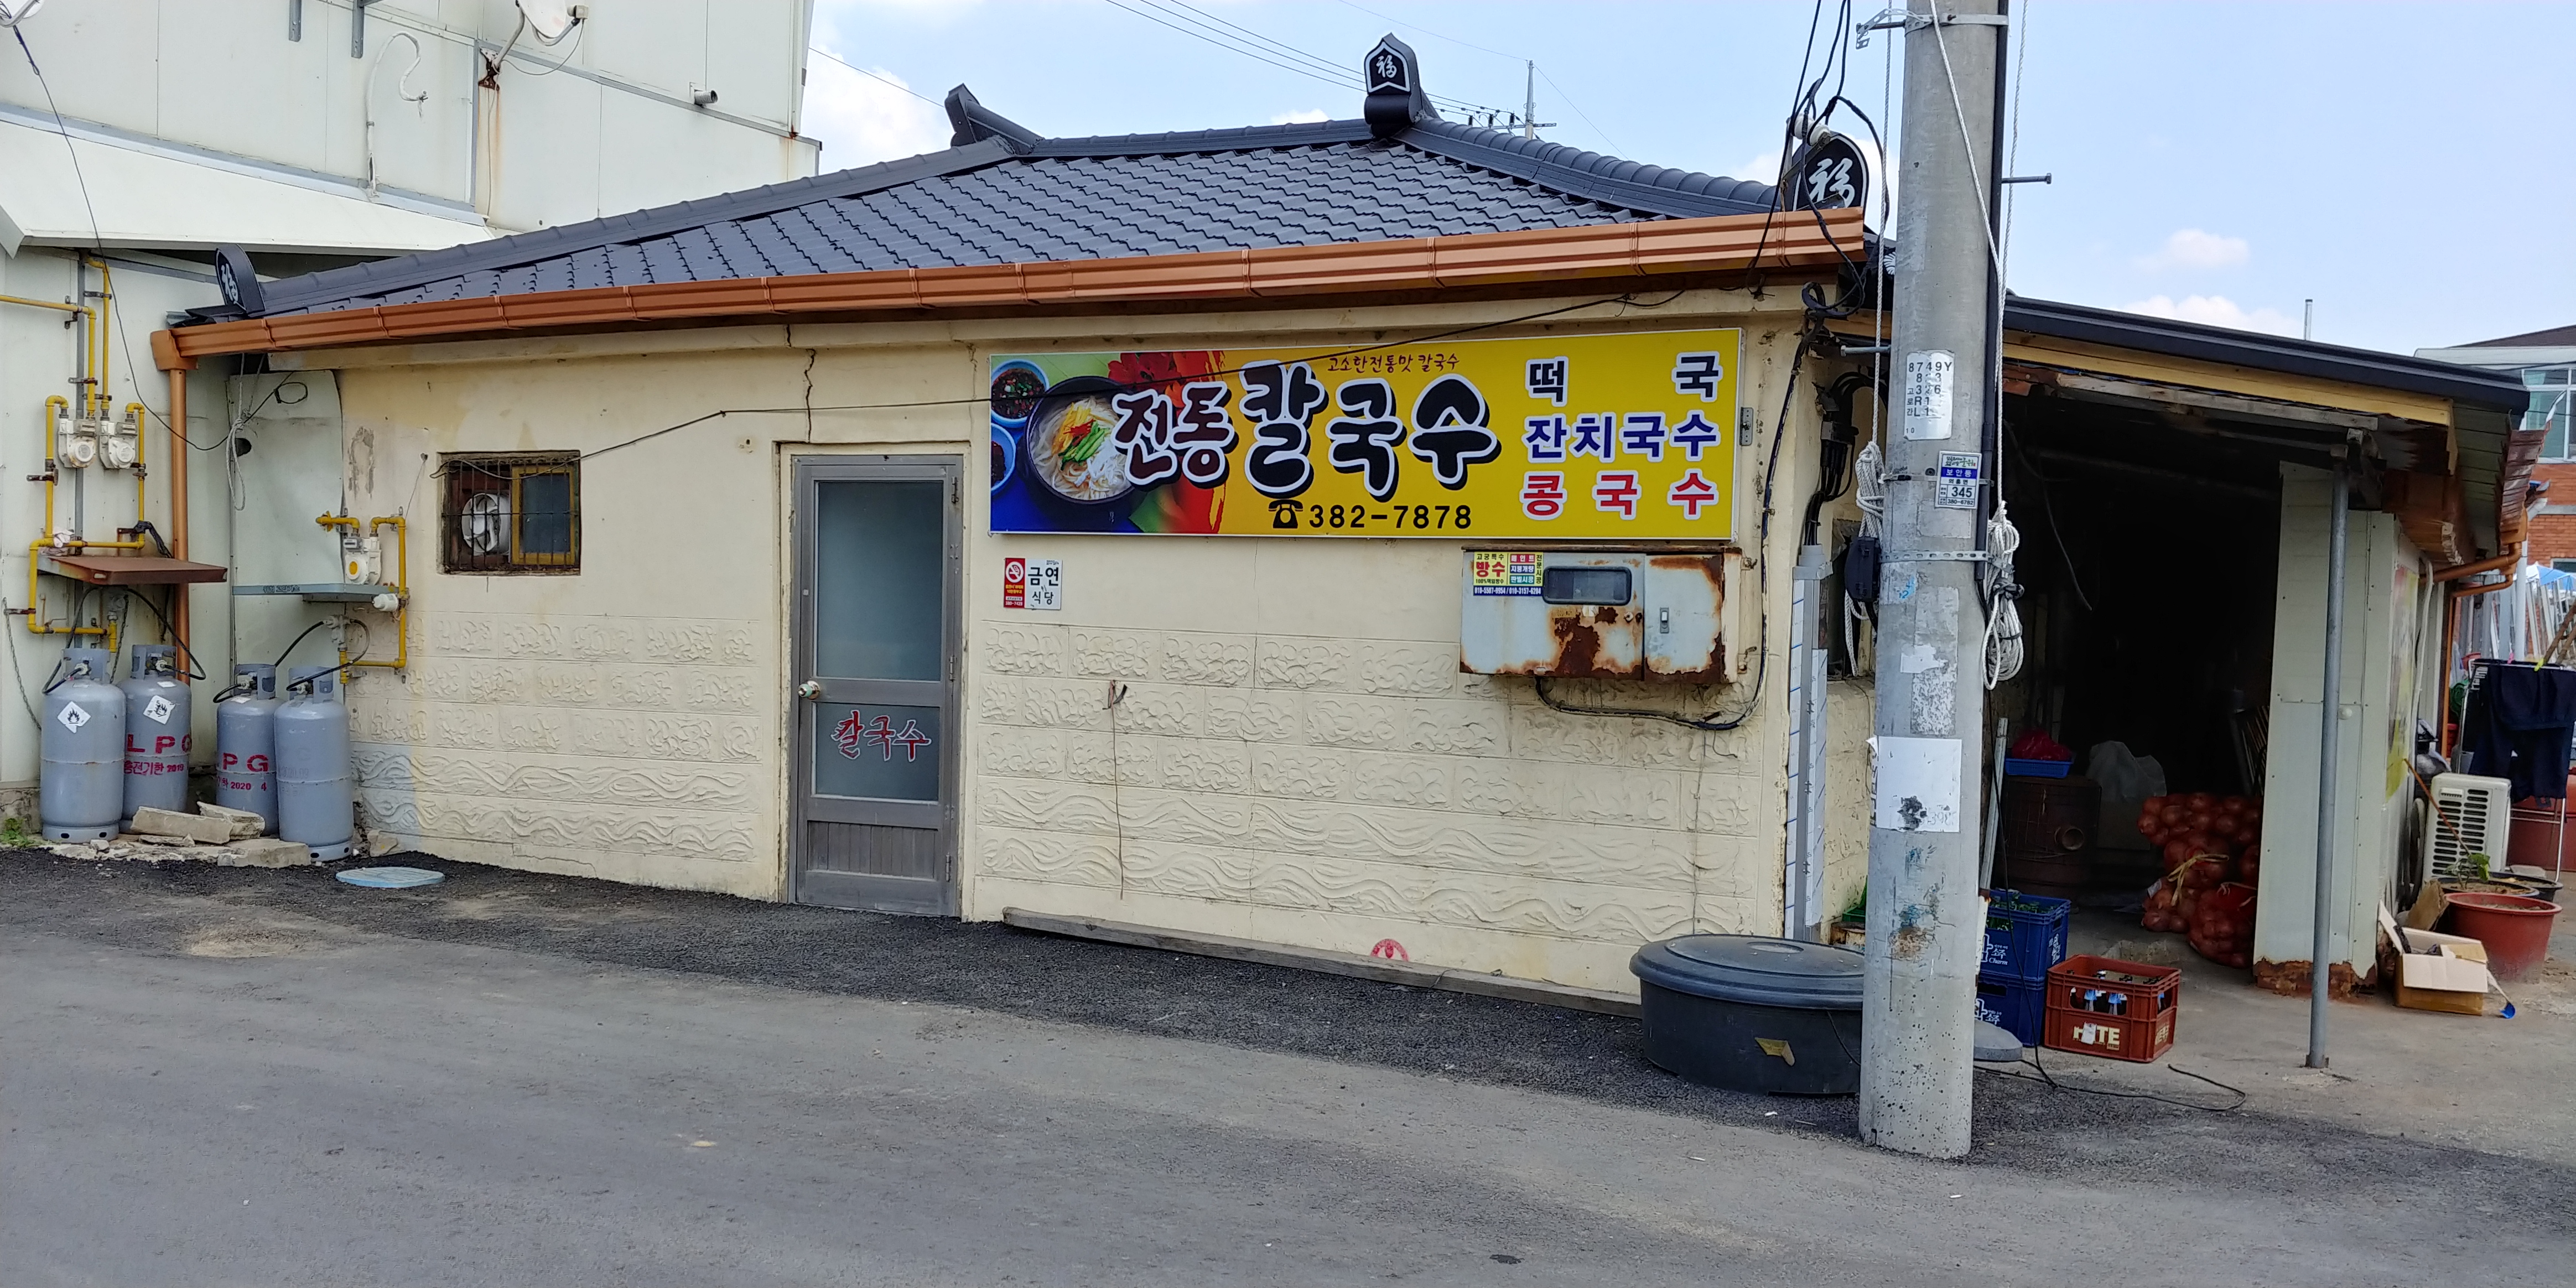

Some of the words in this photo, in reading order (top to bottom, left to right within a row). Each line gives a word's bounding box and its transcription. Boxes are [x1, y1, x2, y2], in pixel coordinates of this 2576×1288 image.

[1376, 55, 1397, 78] 福
[1418, 353, 1460, 372] 칼국수
[1909, 361, 1952, 372] 8749Y
[1112, 381, 1238, 489] 전통
[1239, 360, 1501, 502] 칼국수
[1524, 413, 1718, 460] 잔치국수
[1946, 469, 1972, 477] 보안등
[1951, 486, 1972, 498] 345
[1309, 505, 1471, 529] 382-7878
[1027, 567, 1059, 586] 금연
[1476, 562, 1505, 578] 방수
[1032, 591, 1054, 605] 식당
[830, 710, 932, 762] 칼국수
[231, 781, 251, 791] 2020
[1988, 957, 2008, 965] Charm
[1991, 948, 2007, 959] 소주
[1985, 1013, 2001, 1025] 소주
[2073, 1025, 2120, 1045] HTE
